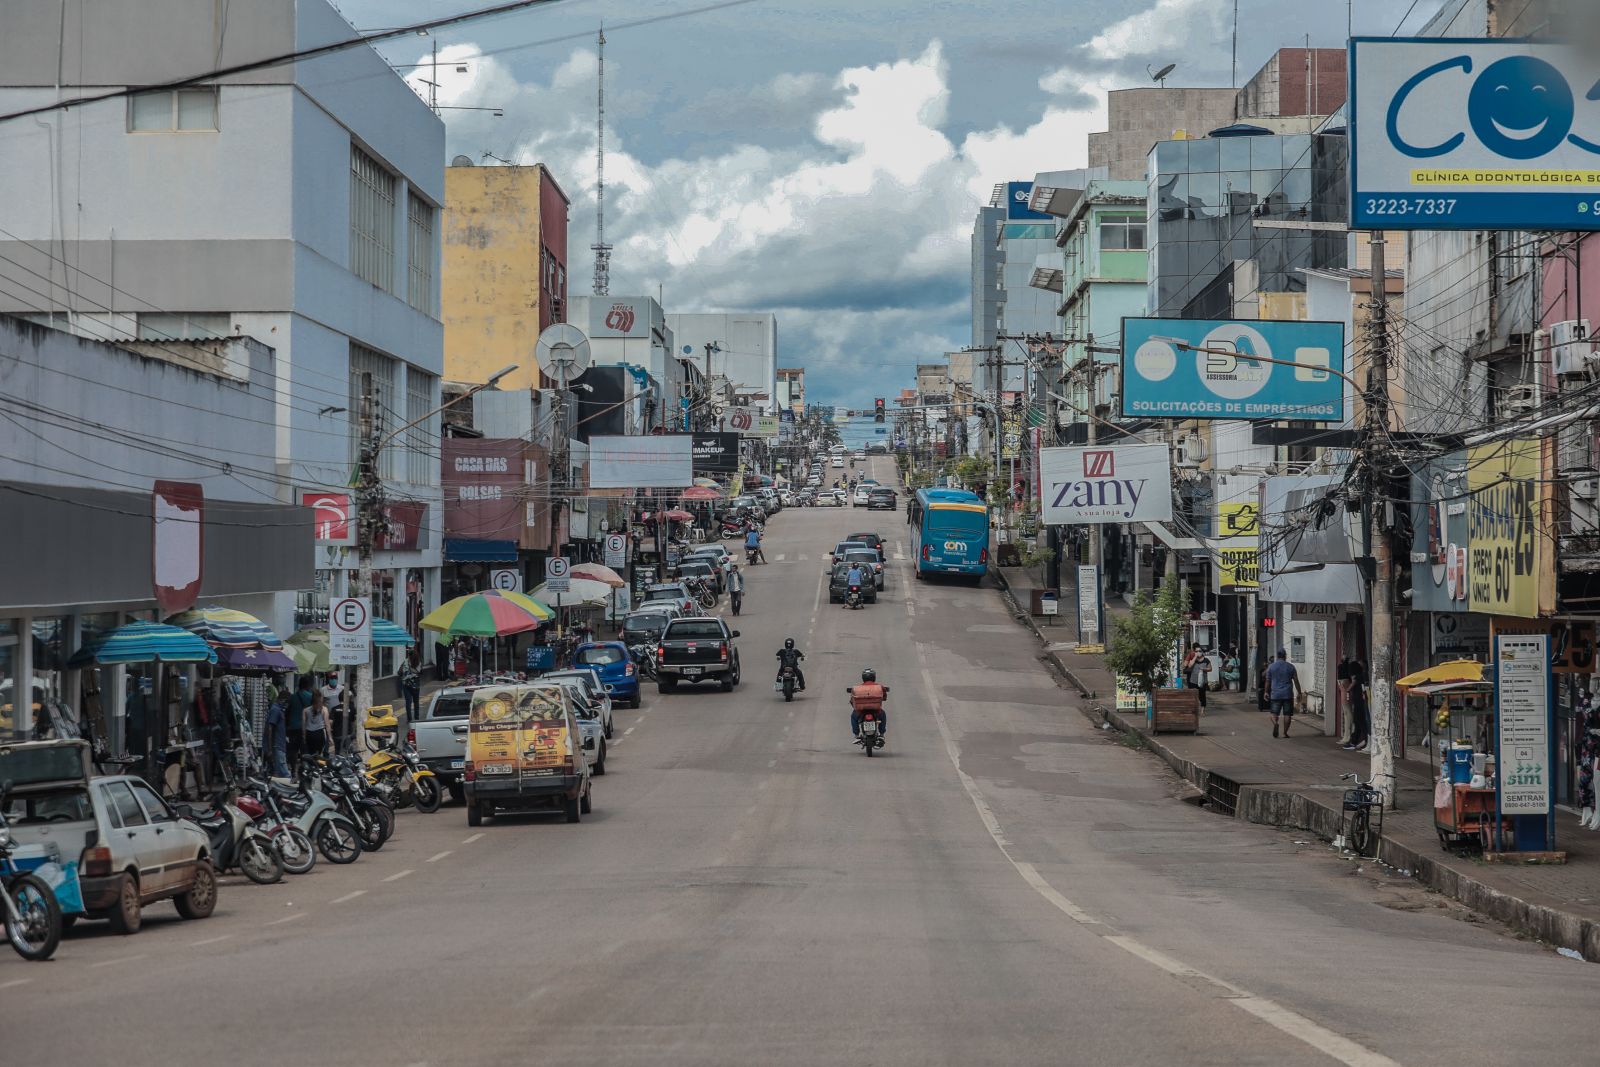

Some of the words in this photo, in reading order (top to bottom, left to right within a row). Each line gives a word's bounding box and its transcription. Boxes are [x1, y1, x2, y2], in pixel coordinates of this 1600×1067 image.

[1416, 171, 1469, 182] CLÍNICA
[1475, 171, 1582, 183] ODONTOLÓGICA
[1366, 198, 1456, 215] 3223-7337
[1133, 400, 1222, 414] SOLICITAÇÕES
[1226, 403, 1241, 413] DE
[1245, 402, 1334, 415] EMPRÉSTIMOS
[455, 457, 484, 472] CASA
[485, 457, 507, 472] DAS
[459, 485, 501, 500] BOLSAS
[1052, 479, 1149, 518] zany
[1515, 477, 1535, 576] 25
[612, 538, 618, 548] E
[554, 561, 561, 573] E
[1495, 546, 1509, 603] 60
[501, 575, 509, 588] E
[345, 604, 355, 625] E
[1507, 774, 1542, 786] sim
[1506, 794, 1544, 802] SEMTRAN
